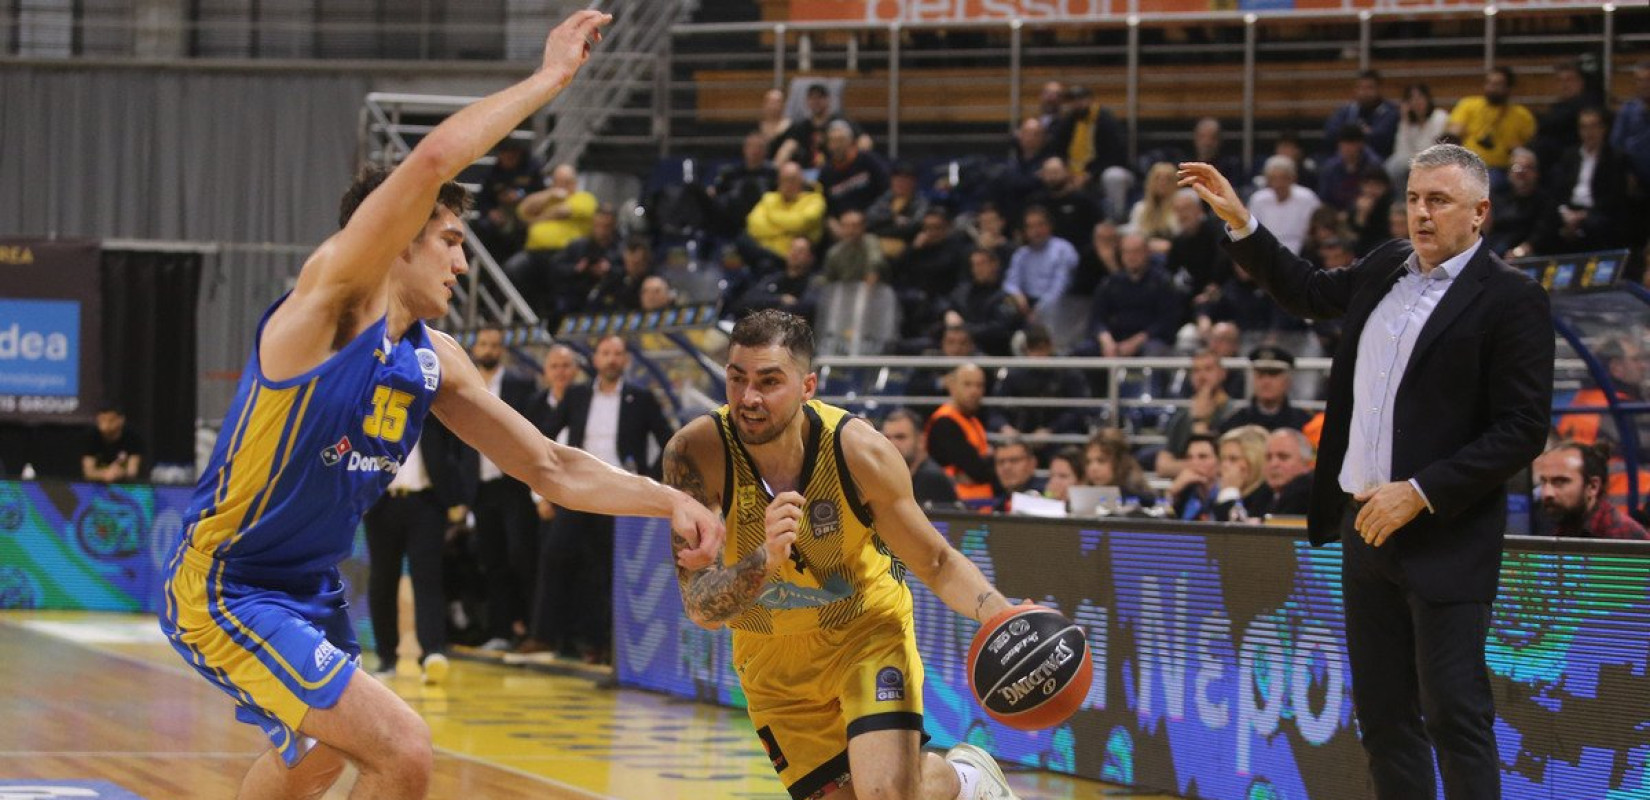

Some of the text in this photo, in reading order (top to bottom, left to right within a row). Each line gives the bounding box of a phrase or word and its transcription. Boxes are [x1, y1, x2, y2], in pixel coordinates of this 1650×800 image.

[18, 396, 79, 413] GROUP
[362, 385, 416, 442] 35
[814, 523, 837, 537] GBL
[998, 638, 1075, 705] SPALDING
[878, 691, 902, 699] GBL
